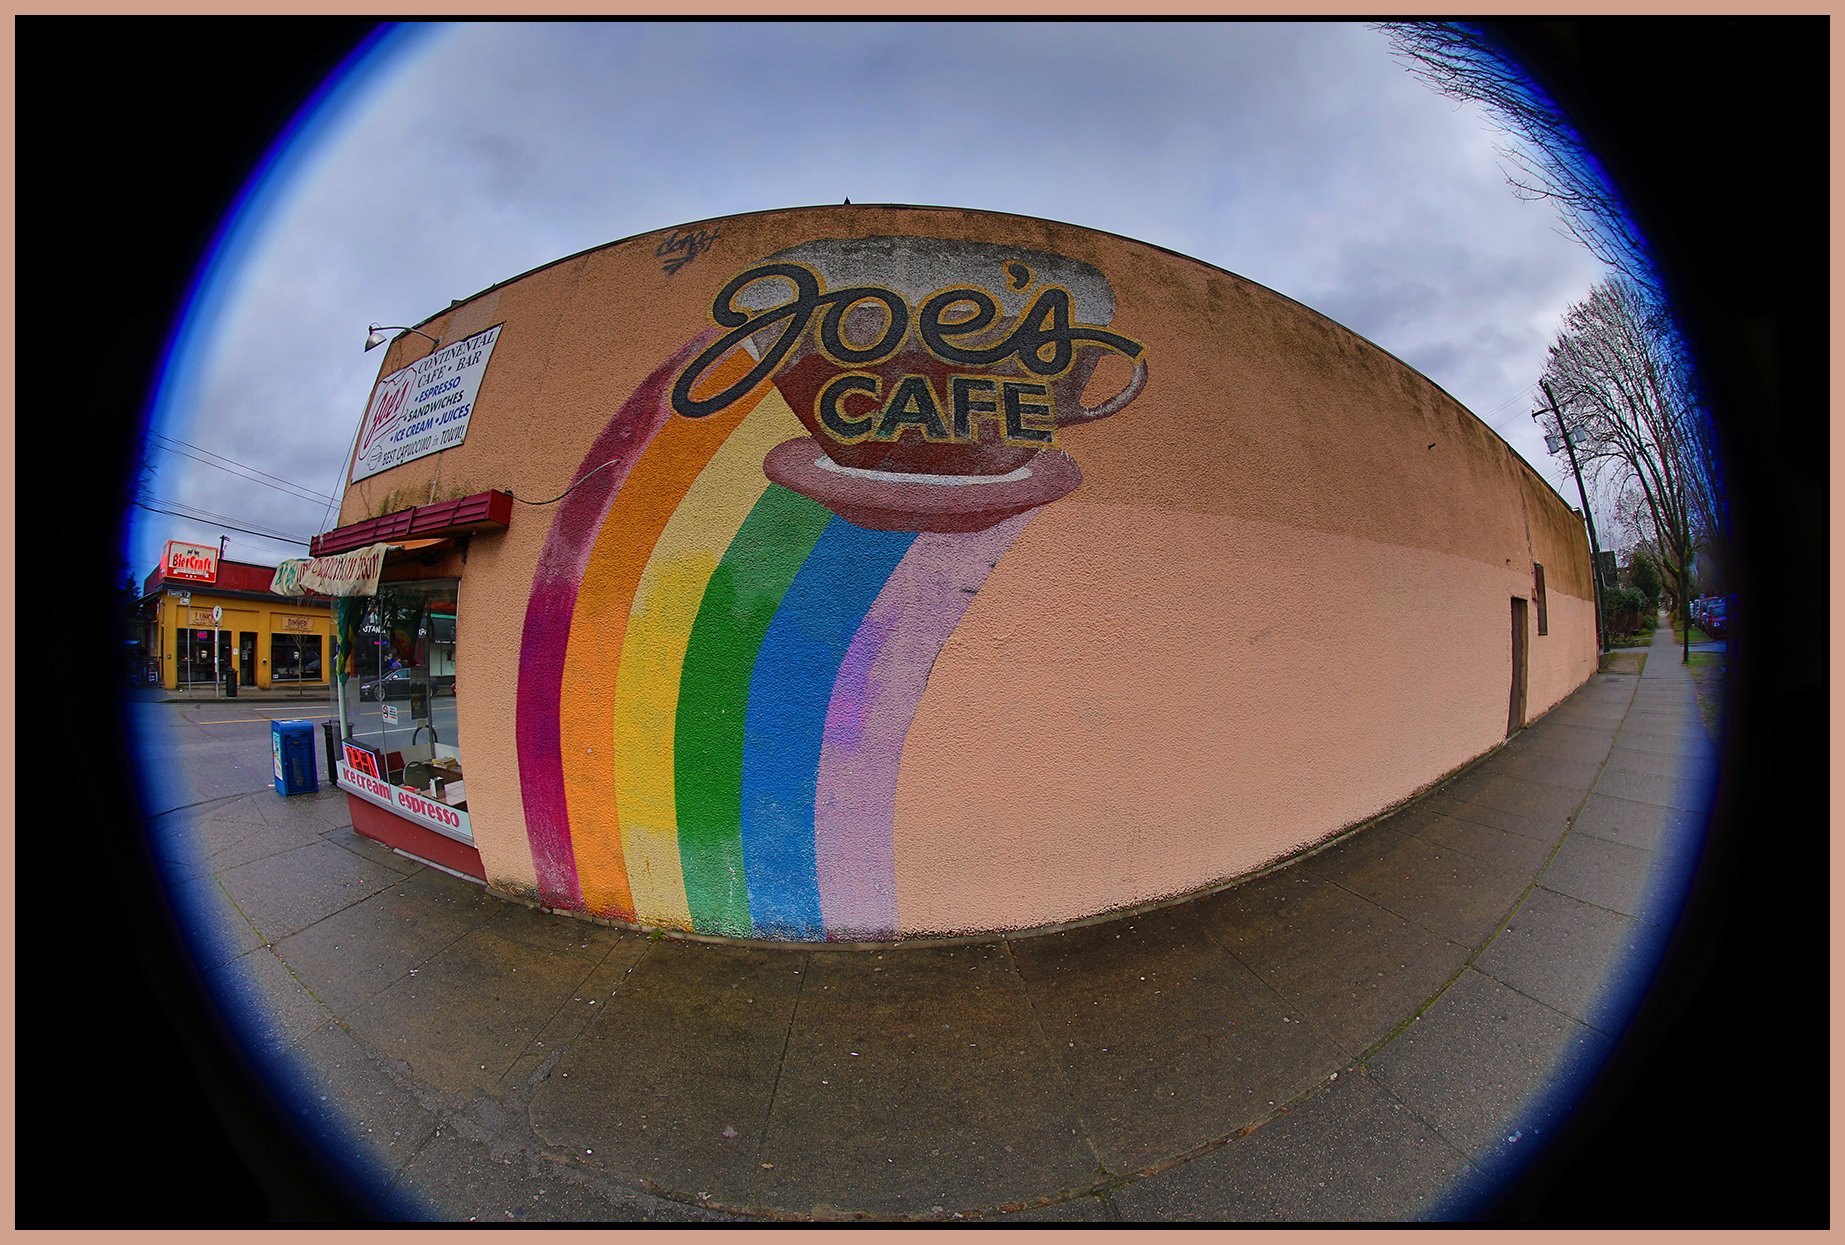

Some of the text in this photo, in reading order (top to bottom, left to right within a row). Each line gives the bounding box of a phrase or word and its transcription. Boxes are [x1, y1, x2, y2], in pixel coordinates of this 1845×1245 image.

[418, 330, 495, 374] CONTINENTAL
[671, 259, 1150, 419] Joe's
[418, 350, 483, 388] CAFE BAR
[407, 389, 465, 423] SANDWICHES
[418, 375, 462, 403] ESPRESSO
[393, 403, 471, 444] ICE CREAM JUICES
[815, 371, 1059, 446] CAFE
[381, 448, 398, 466] BEST
[172, 552, 212, 571] BierCraft
[345, 745, 379, 780] OPEN
[342, 767, 461, 828] ice cream espresso
